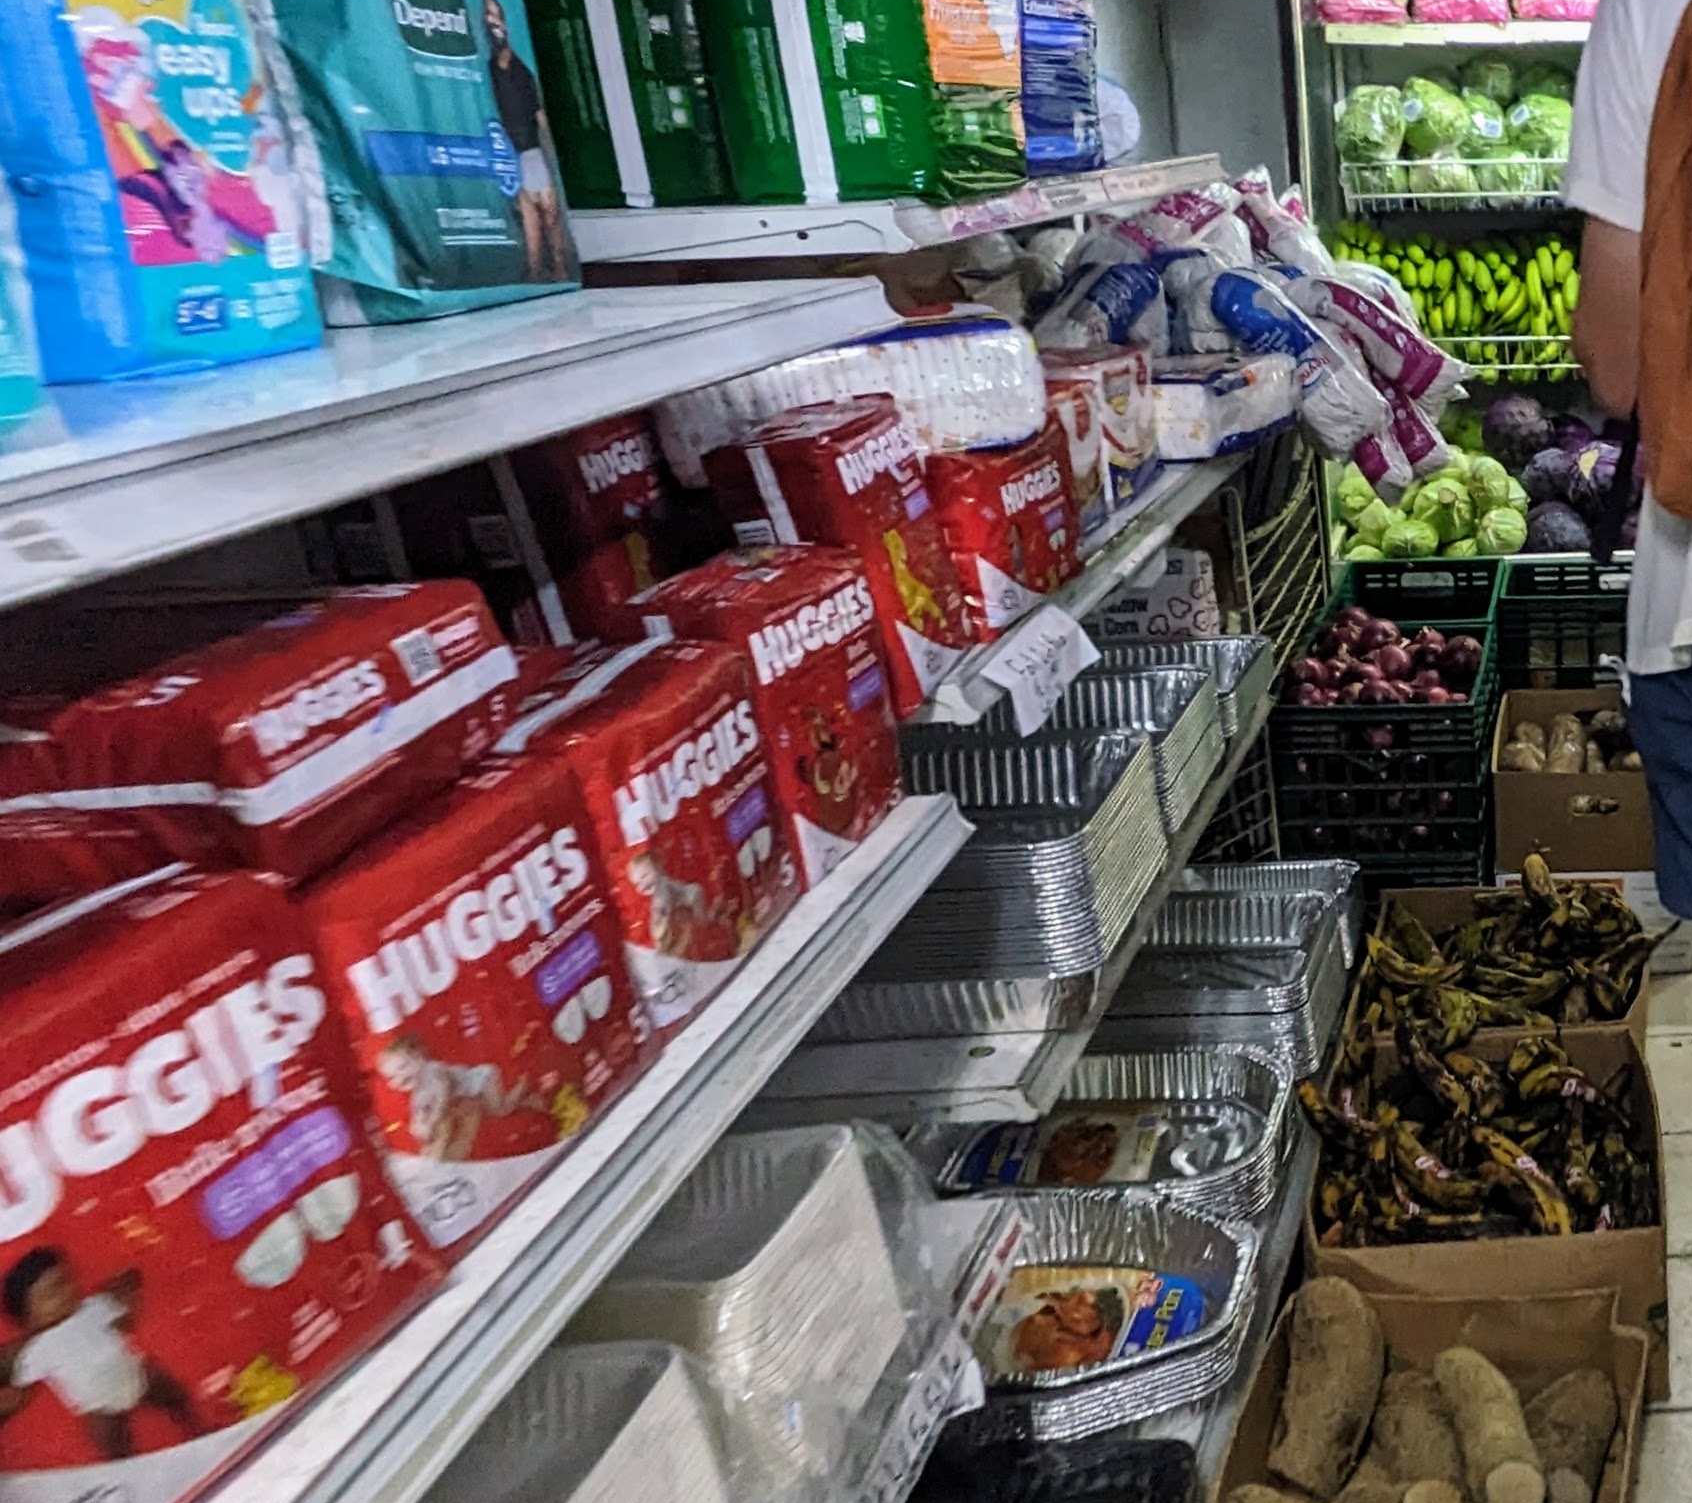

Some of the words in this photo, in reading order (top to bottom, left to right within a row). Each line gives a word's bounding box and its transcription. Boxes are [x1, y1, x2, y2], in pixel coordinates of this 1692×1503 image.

[154, 43, 231, 86] easy
[180, 85, 243, 126] ups
[1000, 460, 1061, 517] HUGGIES
[749, 575, 875, 686] HUGGIES
[613, 698, 759, 848] HUGGIES
[346, 826, 589, 1034] HUGGIES
[0, 953, 327, 1244] UGGIES
